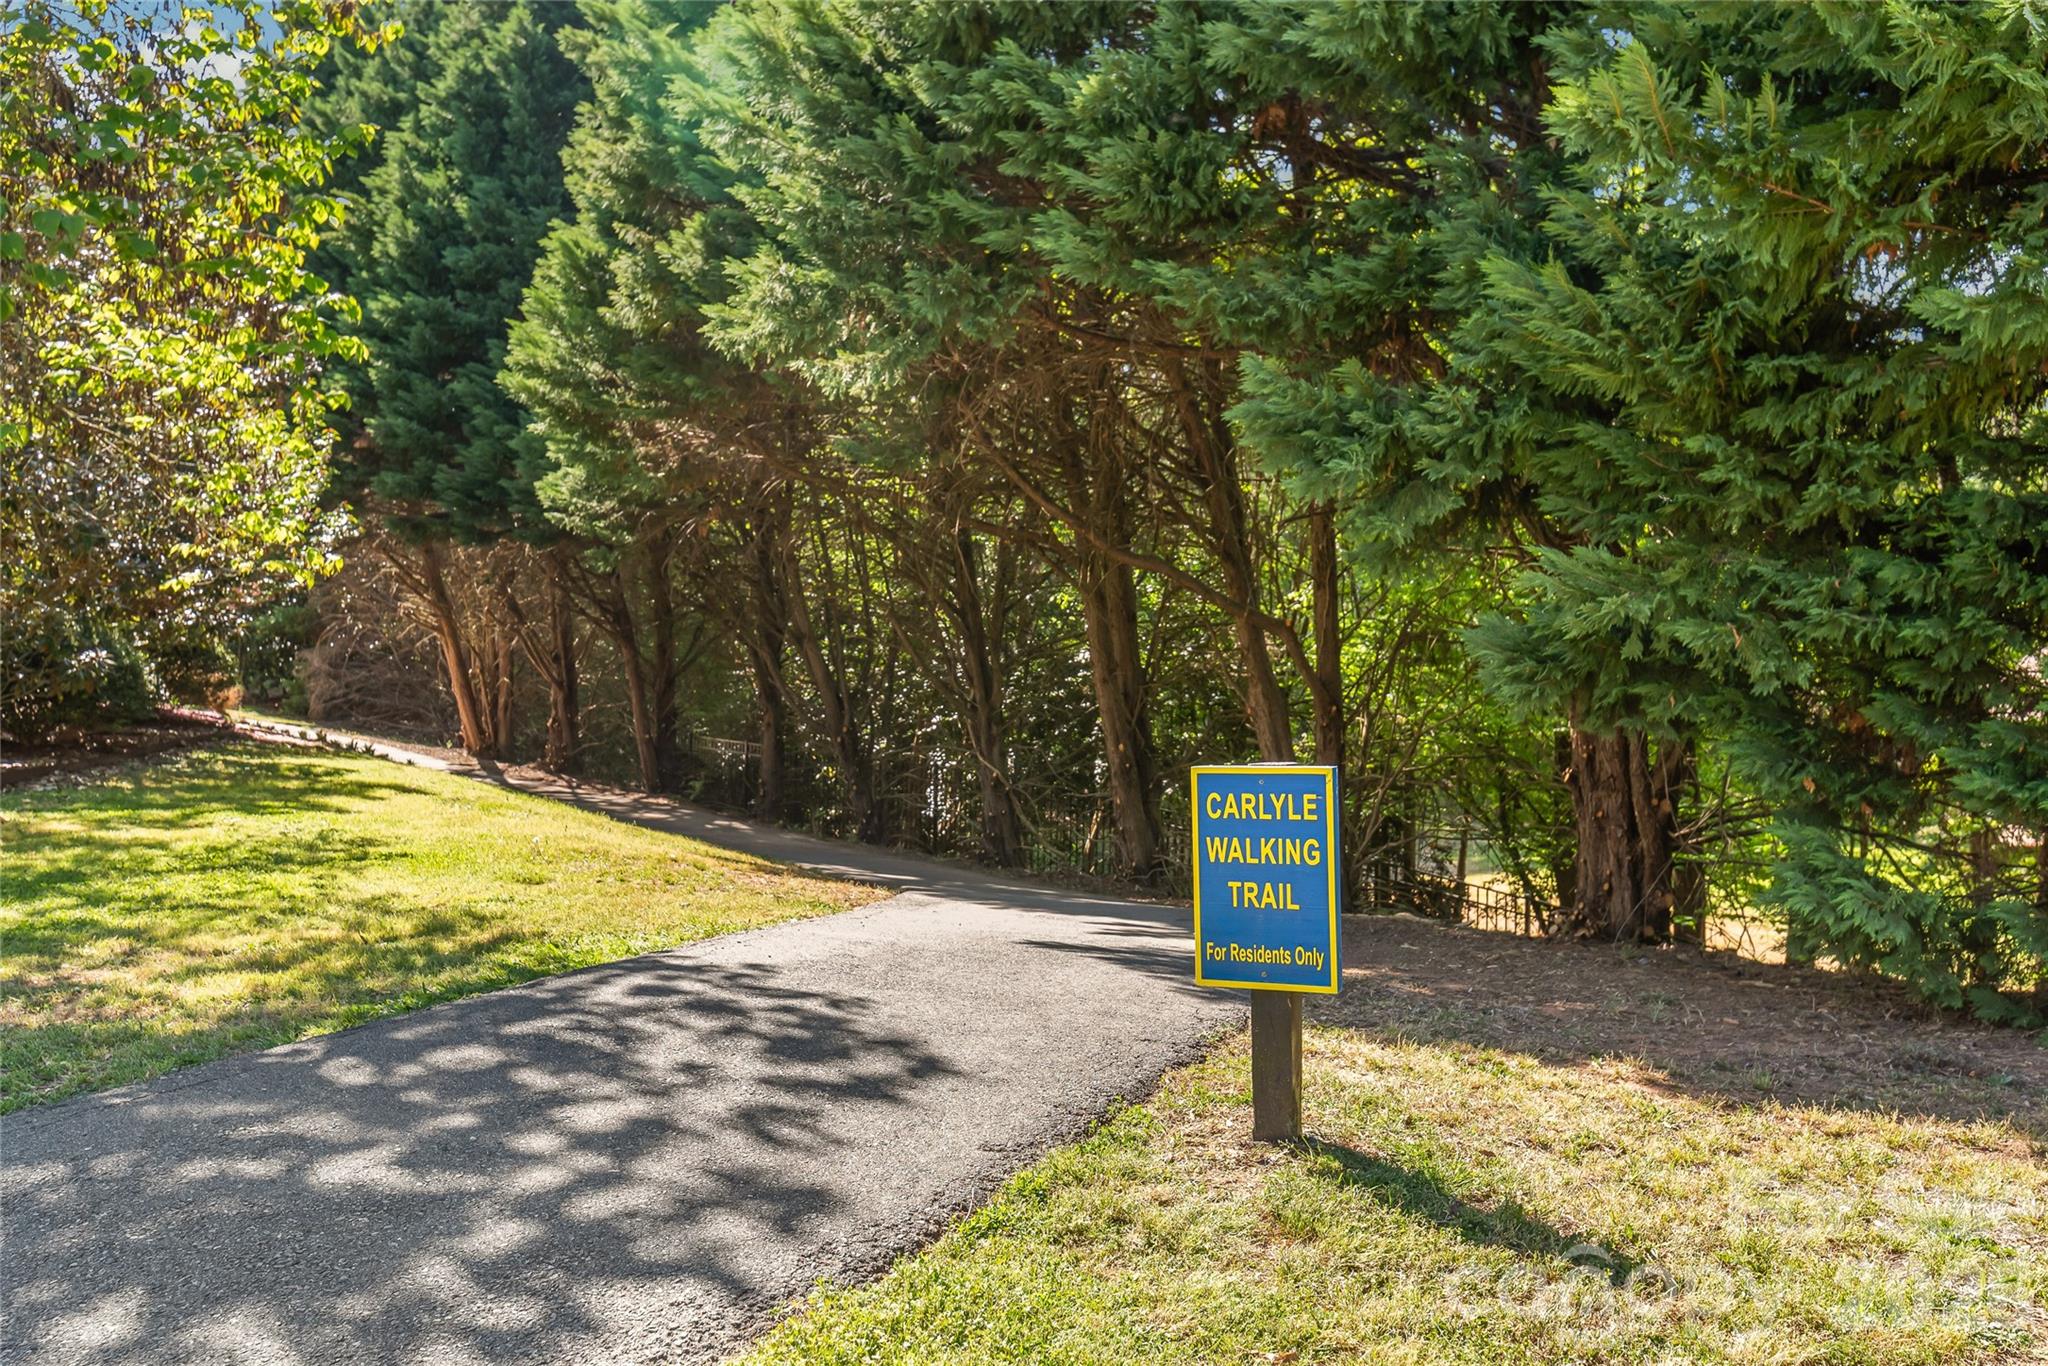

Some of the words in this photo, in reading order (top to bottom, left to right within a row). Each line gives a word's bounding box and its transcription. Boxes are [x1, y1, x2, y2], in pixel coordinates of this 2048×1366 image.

[1206, 792, 1318, 821] CARLYLE
[1205, 837, 1321, 866] WALKING
[1227, 881, 1300, 911] TRAIL
[1206, 942, 1226, 961] For
[1230, 943, 1291, 965] Residents
[1295, 946, 1325, 971] Only
